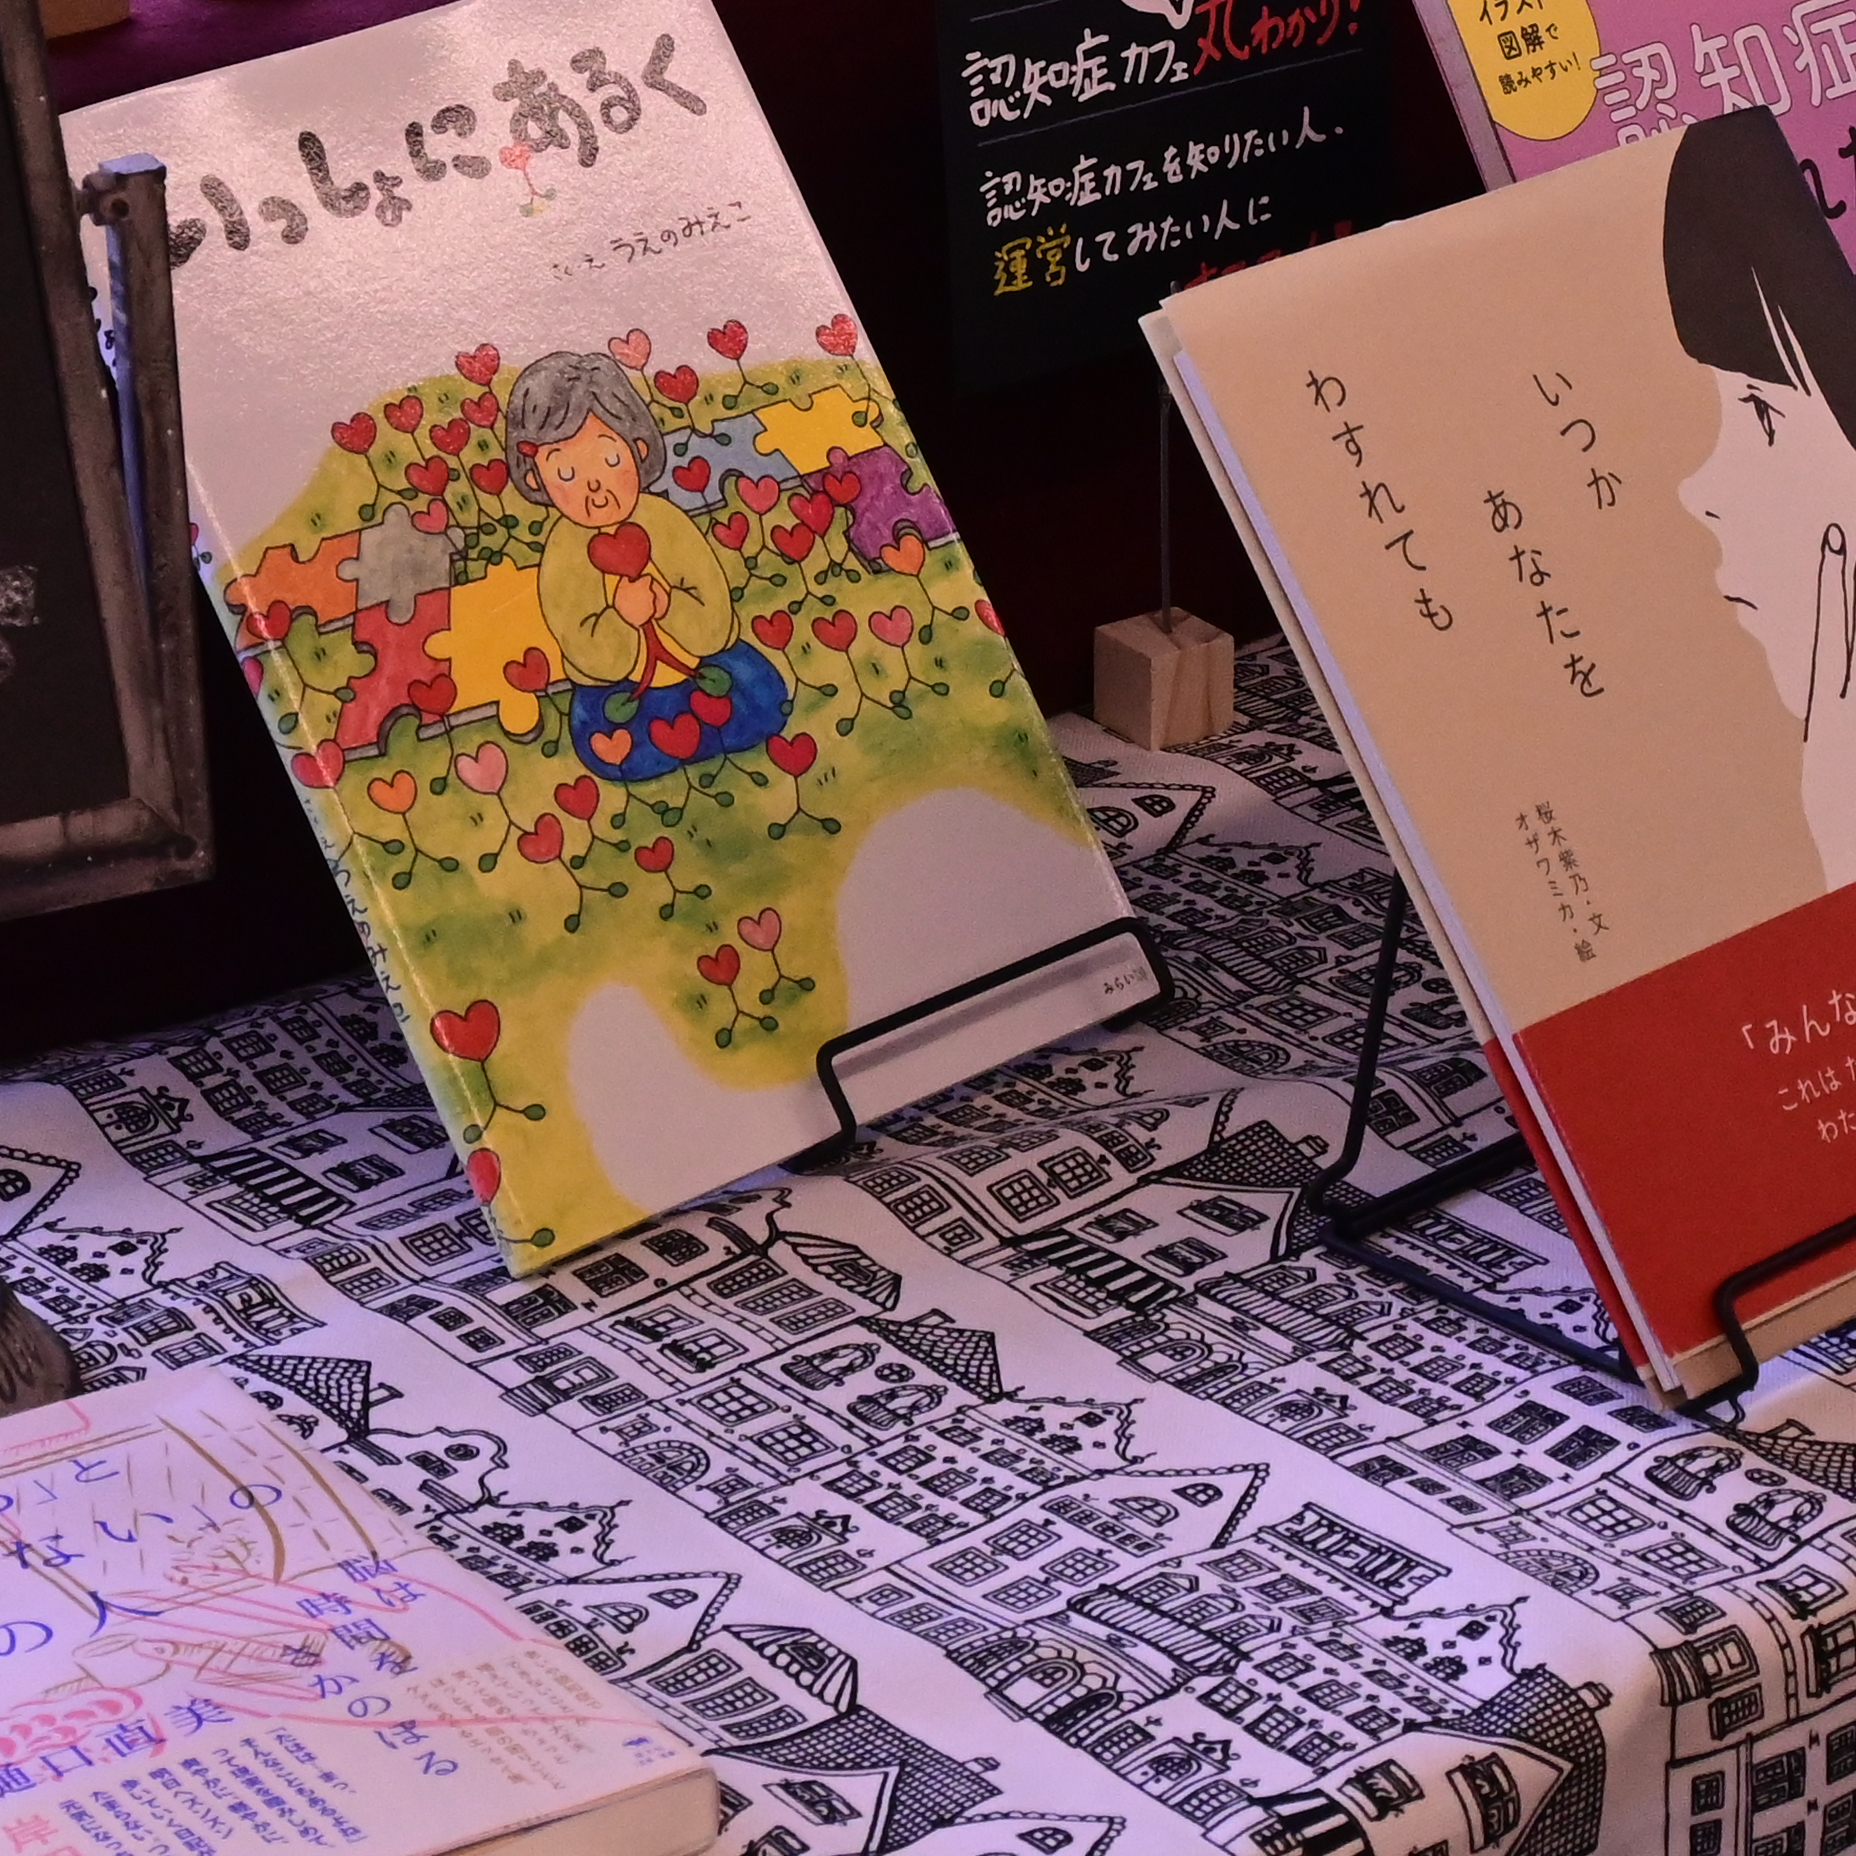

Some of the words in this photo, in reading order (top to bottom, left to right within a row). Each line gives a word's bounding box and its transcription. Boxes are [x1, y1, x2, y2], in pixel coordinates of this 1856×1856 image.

[1497, 22, 1560, 61] 図解で
[1497, 52, 1583, 97] 読みやすい!
[170, 34, 706, 271] いっしょにあるく
[611, 200, 753, 264] うえのみえこ
[993, 196, 1272, 297] 運営してみたい人に
[1532, 372, 1622, 510] いつか
[1306, 370, 1454, 632] わすれても
[1483, 489, 1605, 698] あなたを
[1535, 801, 1610, 936] 桜木紫乃・文
[1776, 1068, 1843, 1112] これは
[337, 1555, 425, 1608] 脳は
[296, 1592, 419, 1676] 時間を
